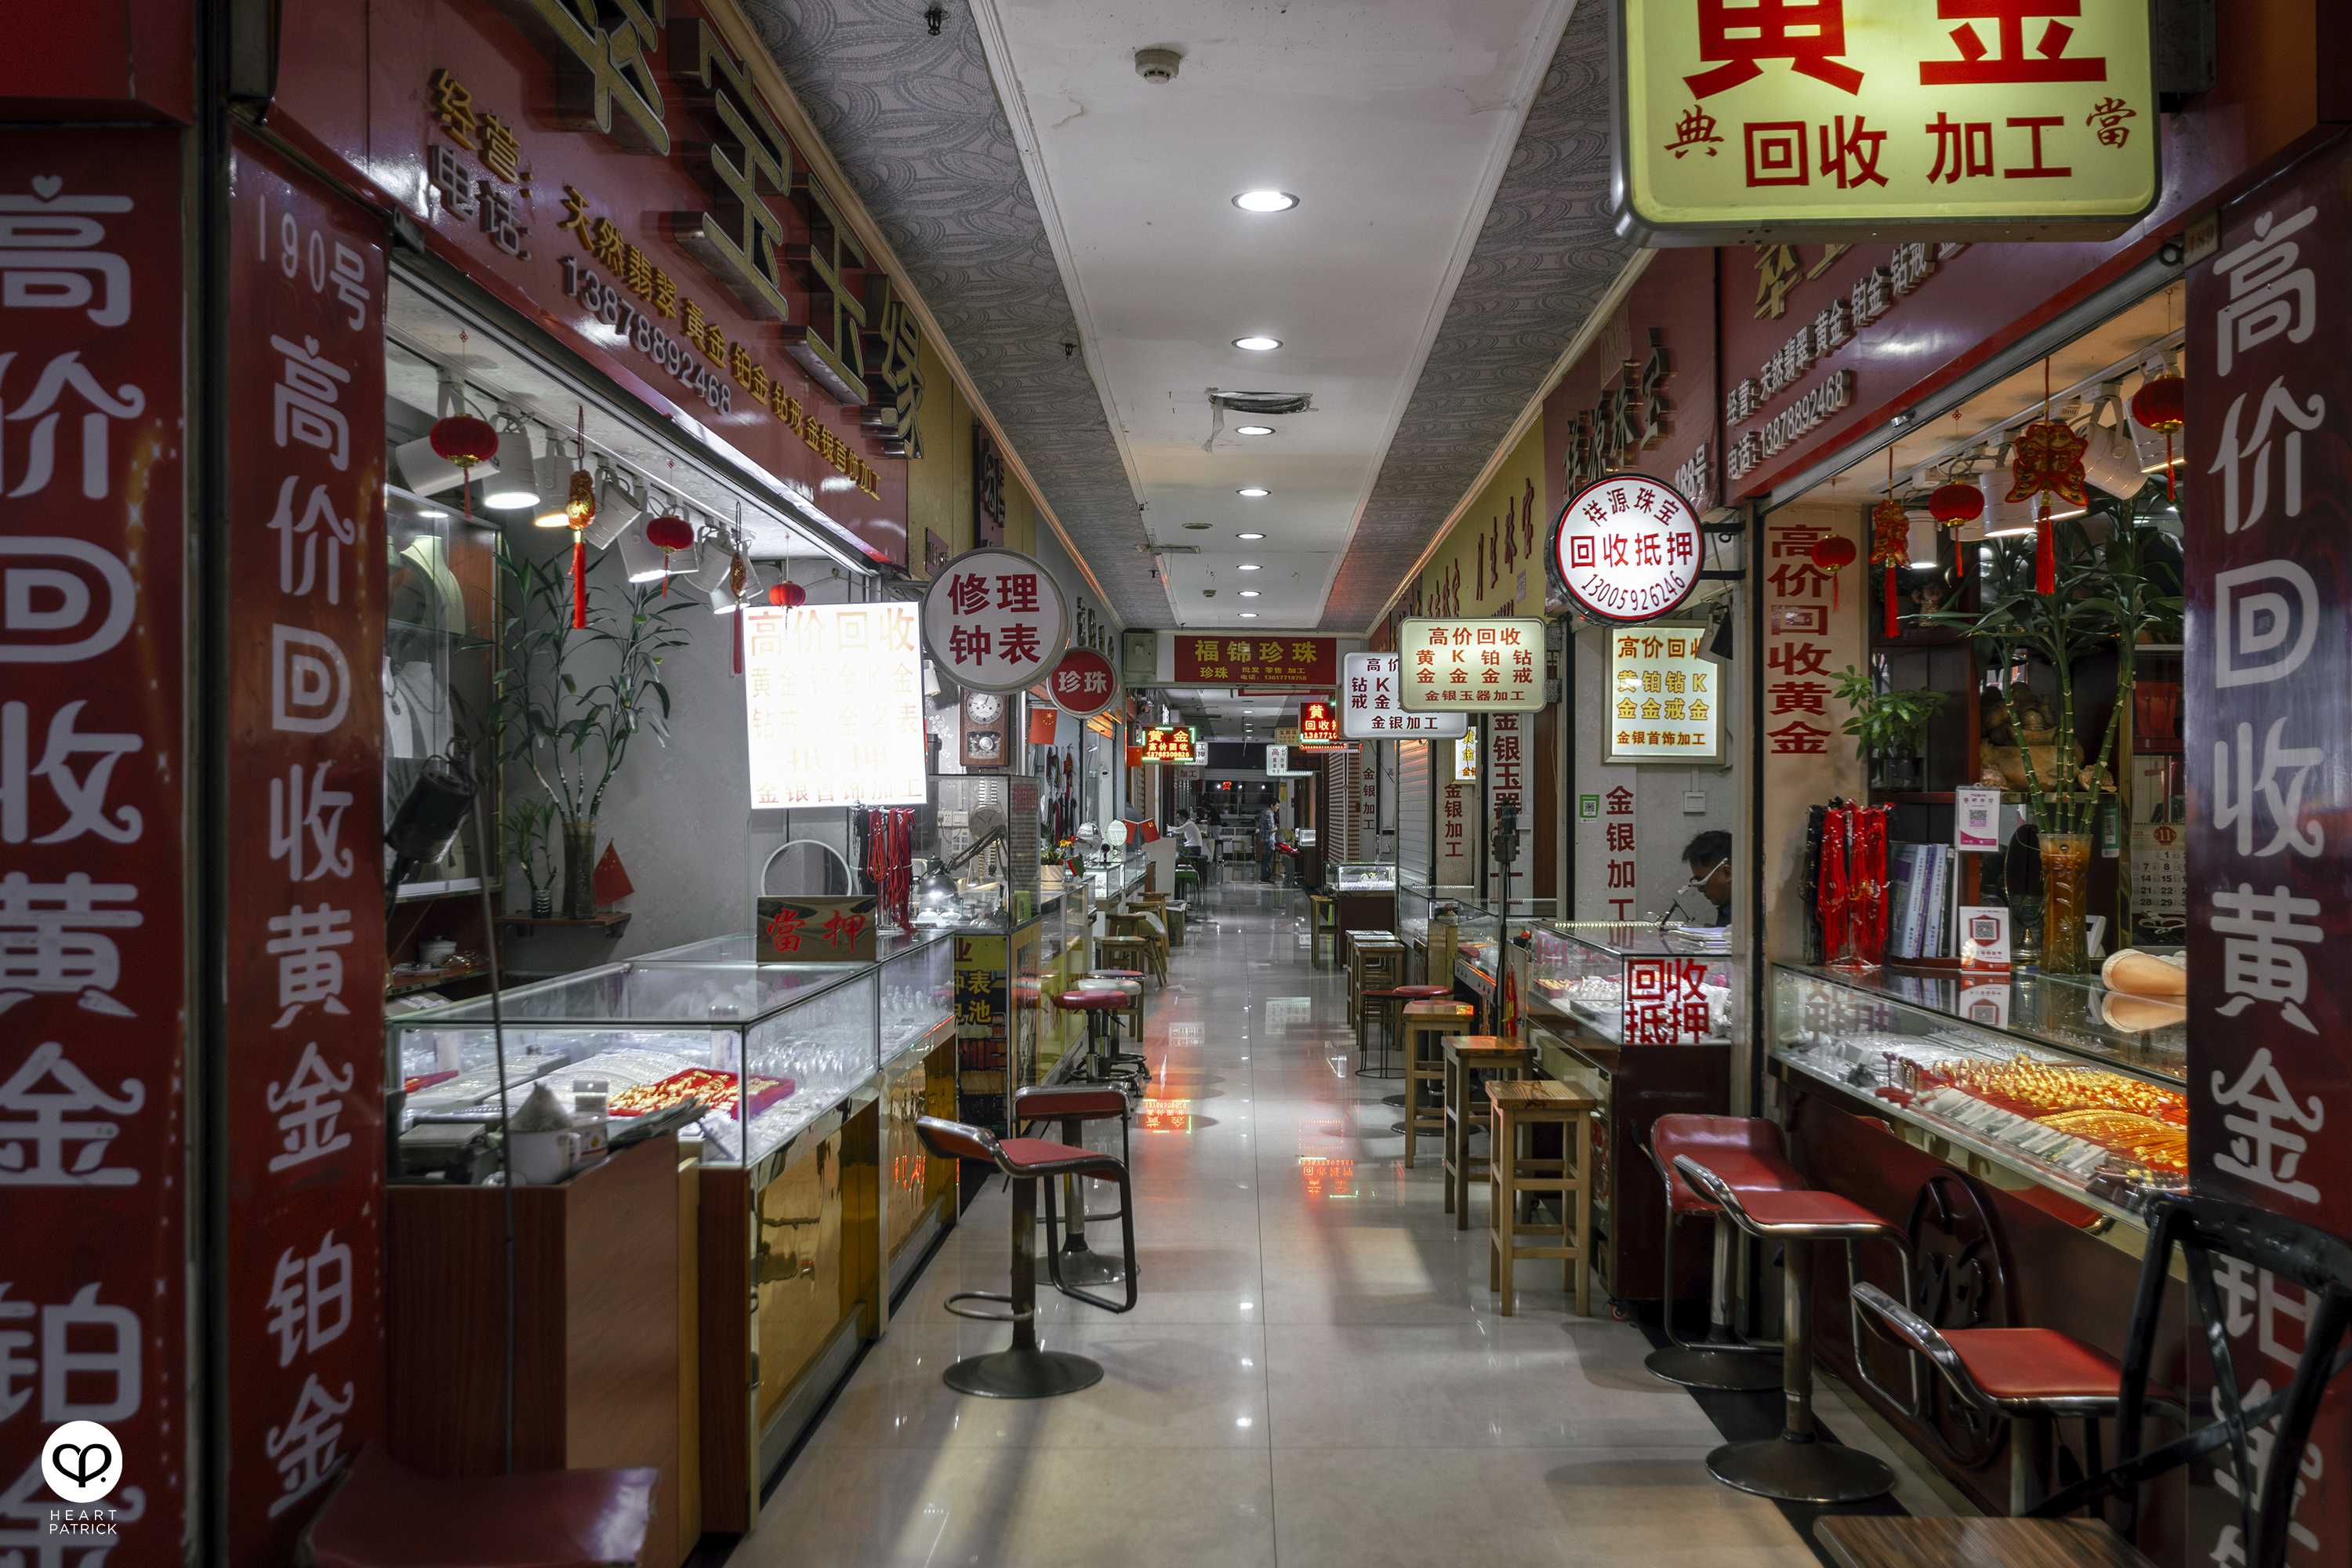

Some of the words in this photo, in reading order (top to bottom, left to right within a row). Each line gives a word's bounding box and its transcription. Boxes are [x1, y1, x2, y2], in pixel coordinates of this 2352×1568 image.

[1744, 114, 1889, 189] 回收
[1926, 112, 2073, 184] 加工
[561, 185, 677, 319] 天然翡翠
[683, 298, 727, 368] 黄金
[731, 342, 769, 405] 铂金
[771, 381, 803, 436] 钻戒
[805, 416, 881, 501] 金银首饰加工
[564, 256, 731, 416] 13878892468
[1760, 325, 1809, 401] 天然翡翠
[1852, 267, 1884, 327] 铂金
[1761, 369, 1846, 459] 13878892468
[1582, 487, 1680, 528] 祥源珠宝
[1571, 532, 1693, 568] 回收抵押
[947, 572, 1040, 615] 修理
[1581, 570, 1686, 611] 13005926246
[748, 607, 915, 656] 高价回收
[949, 623, 1041, 666] 钟表
[1195, 640, 1318, 663] 福锦珍珠
[1428, 627, 1521, 645] 高价回收
[1767, 524, 1832, 755] 高价回收黄金
[1058, 670, 1107, 694] 珍珠
[1200, 666, 1229, 679] 珍珠
[1309, 705, 1324, 719] 黄
[1425, 690, 1525, 701] 金银玉器加工
[1148, 730, 1189, 742] 黄金
[1371, 716, 1439, 729] 金银加工
[1617, 730, 1706, 746] 金银首饰加工
[787, 743, 888, 774] 抵押
[1149, 742, 1189, 752] 高价回收
[757, 778, 922, 804] 金银首饰加工
[1179, 769, 1197, 778] 加工
[1363, 767, 1376, 829] 金银加工
[1490, 713, 1523, 877] 金银玉器
[1444, 784, 1463, 857] 金银加工
[1606, 786, 1635, 921] 金银加工
[767, 907, 866, 953] 當押
[1627, 958, 1708, 1003] 回收
[1625, 1002, 1710, 1044] 抵押
